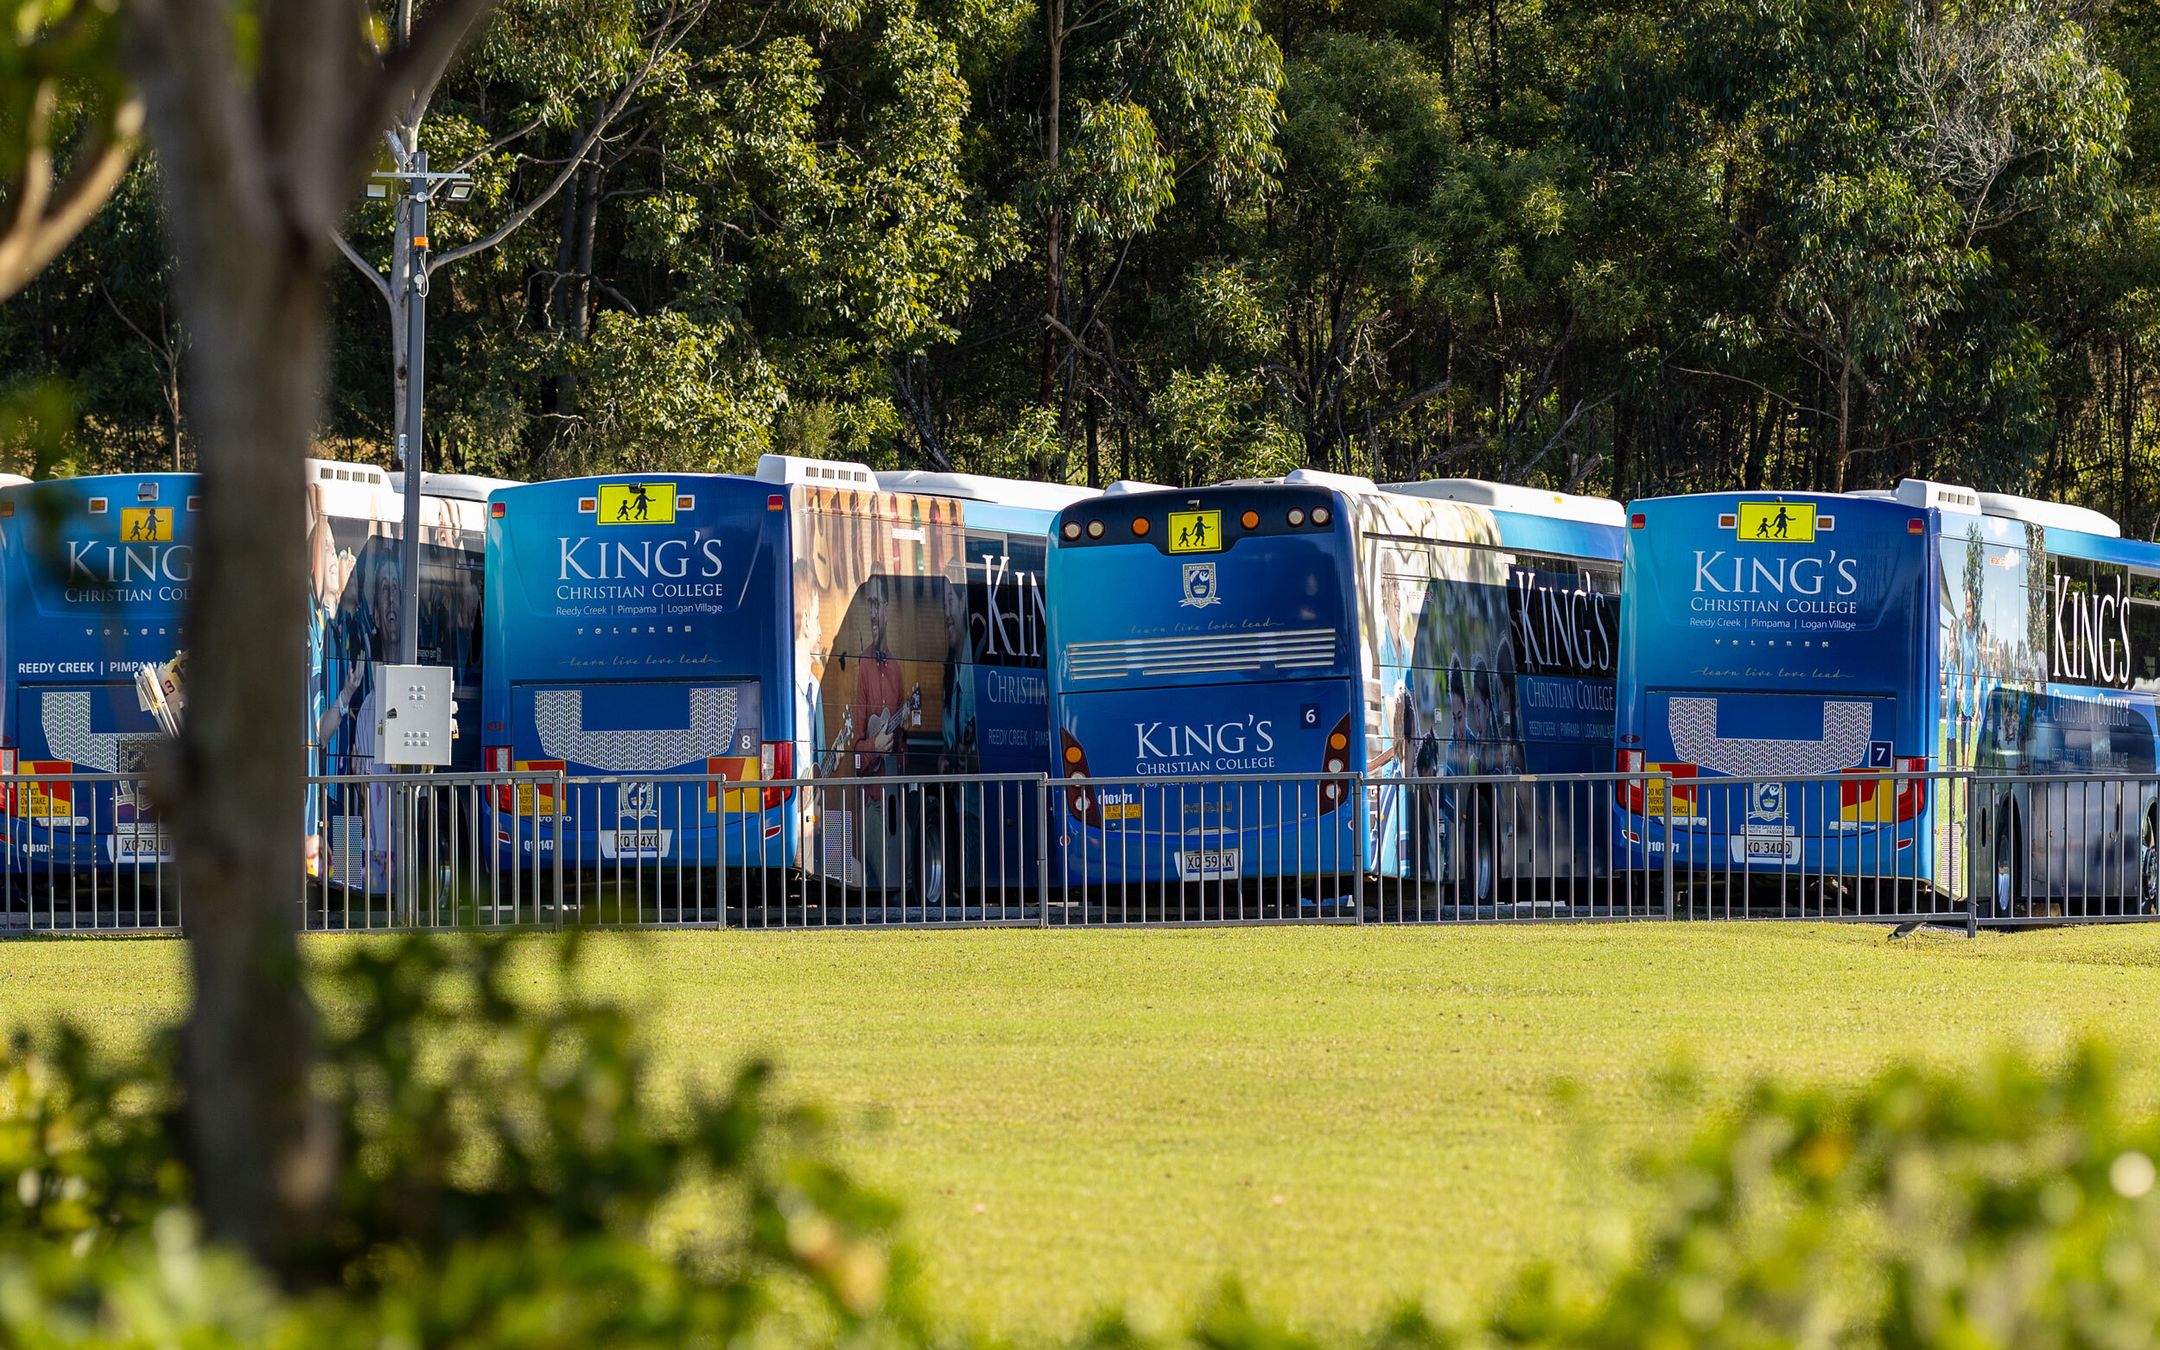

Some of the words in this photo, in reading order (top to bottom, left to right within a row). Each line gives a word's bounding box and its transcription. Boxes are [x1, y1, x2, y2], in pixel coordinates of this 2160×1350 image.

[67, 541, 193, 582] KING
[557, 530, 723, 581] KING'S
[1692, 550, 1857, 595] KING'S
[64, 587, 152, 603] CHRISTIAN
[556, 585, 645, 600] CHRISTIAN
[652, 582, 723, 598] COLLEGE
[556, 606, 582, 617] Reedy
[583, 605, 608, 615] Creek
[617, 604, 657, 616] Pimpama
[667, 603, 694, 615] Logan
[695, 602, 723, 615] Village
[982, 554, 1046, 657] KIN
[1690, 597, 1779, 613] CHRISTIAN
[1786, 598, 1857, 614] COLLEGE
[1516, 571, 1610, 671] KING'S
[1690, 617, 1716, 628] Reedy
[1717, 618, 1741, 627] Creek
[1751, 618, 1791, 629] Pimpama
[1801, 619, 1827, 630] Logan
[1828, 619, 1857, 631] Village
[2053, 574, 2131, 684] KING'S
[18, 662, 55, 674] REEDY
[58, 662, 95, 673] CREEK
[613, 655, 640, 666] live
[646, 654, 674, 665] love
[680, 653, 722, 664] lead
[1745, 666, 1773, 677] live
[1778, 667, 1807, 678] love
[1812, 668, 1855, 679] lead
[987, 670, 1048, 705] CHRISTIA
[1526, 677, 1575, 709] CHRISTIAN
[1576, 680, 1614, 711] COLLEGE
[1305, 708, 1316, 724] 6
[2053, 688, 2096, 722] CHRISTIAN
[2097, 693, 2130, 726] COLLEGE
[742, 735, 751, 749] 8
[1134, 713, 1274, 759] KING'S
[1876, 747, 1886, 762] 7
[1136, 761, 1211, 775] CHRISTIAN
[1215, 757, 1275, 771] COLLEGE
